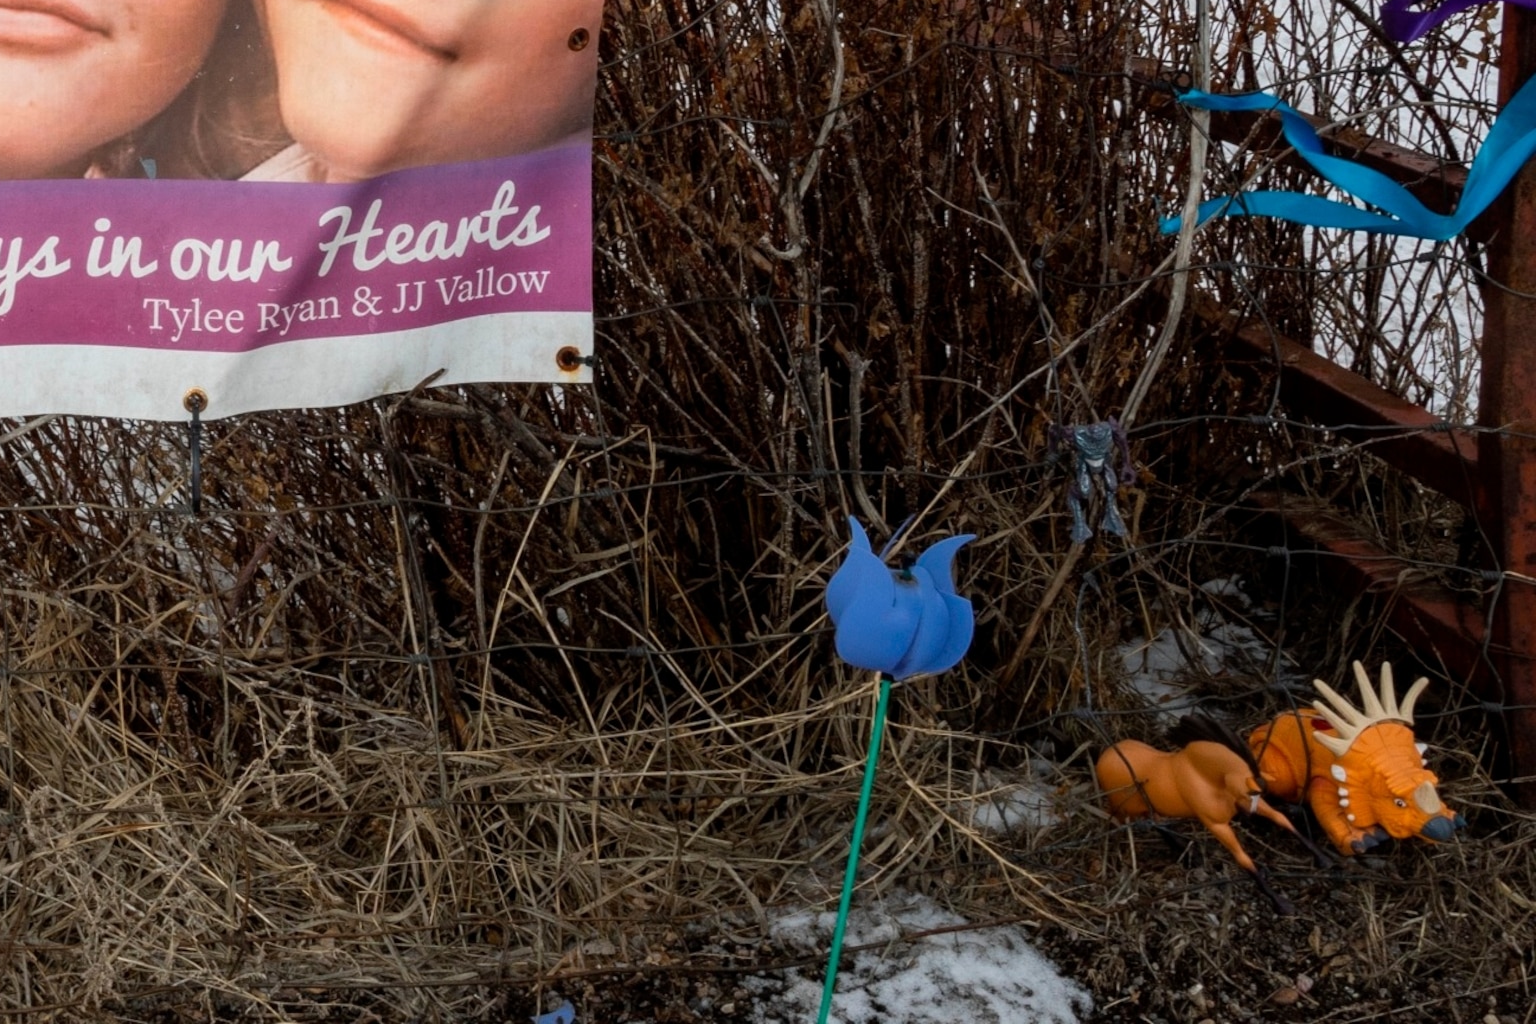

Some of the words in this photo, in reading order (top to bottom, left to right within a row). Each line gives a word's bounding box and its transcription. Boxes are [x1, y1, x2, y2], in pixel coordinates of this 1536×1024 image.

[86, 217, 158, 279] in
[170, 236, 292, 283] our
[318, 179, 551, 277] Hearts
[142, 297, 245, 342] Tylee
[257, 294, 341, 336] Ryan
[351, 285, 383, 317] &
[391, 281, 427, 314] JJ
[434, 266, 551, 307] Vallow
